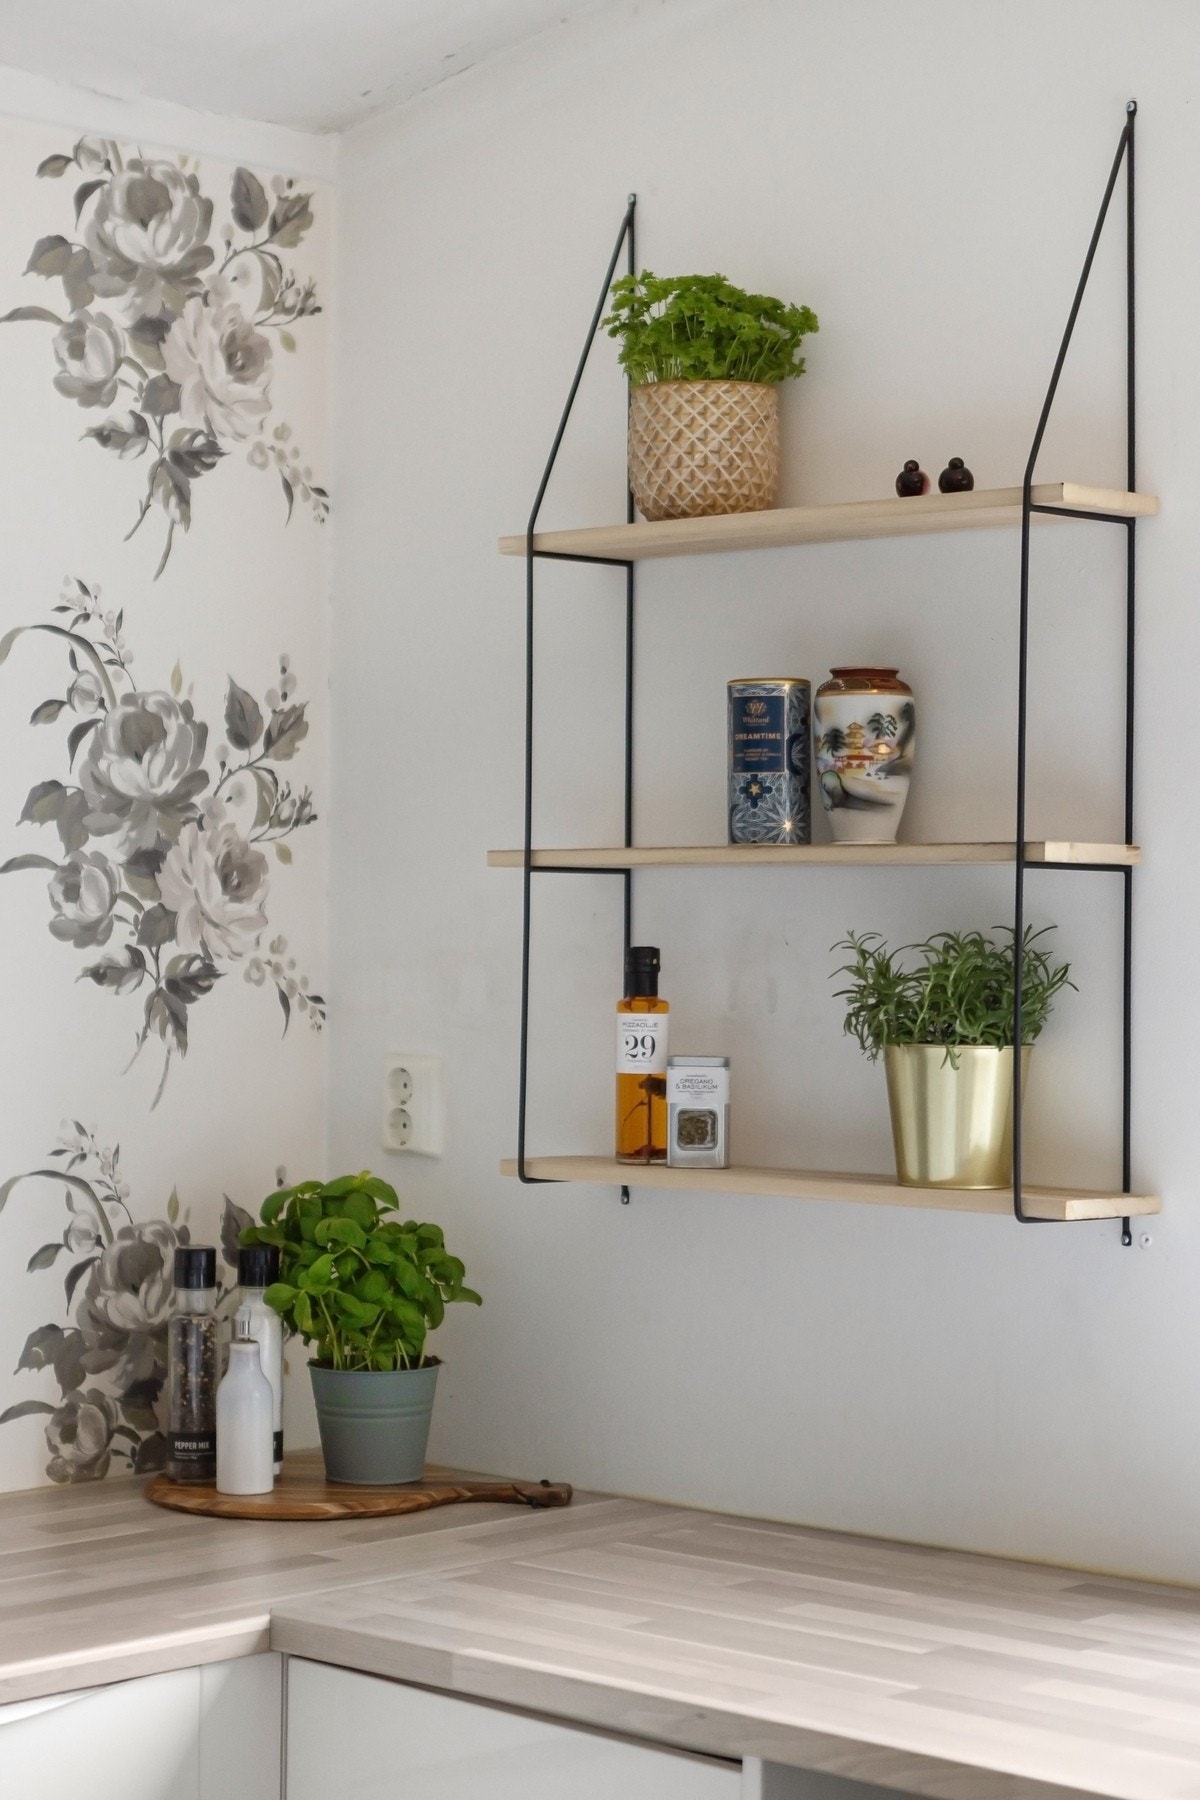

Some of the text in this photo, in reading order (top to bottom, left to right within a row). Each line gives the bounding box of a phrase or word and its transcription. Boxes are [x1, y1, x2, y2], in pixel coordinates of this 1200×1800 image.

[625, 1034, 656, 1059] 29
[174, 1441, 210, 1450] PEPPER MIX
